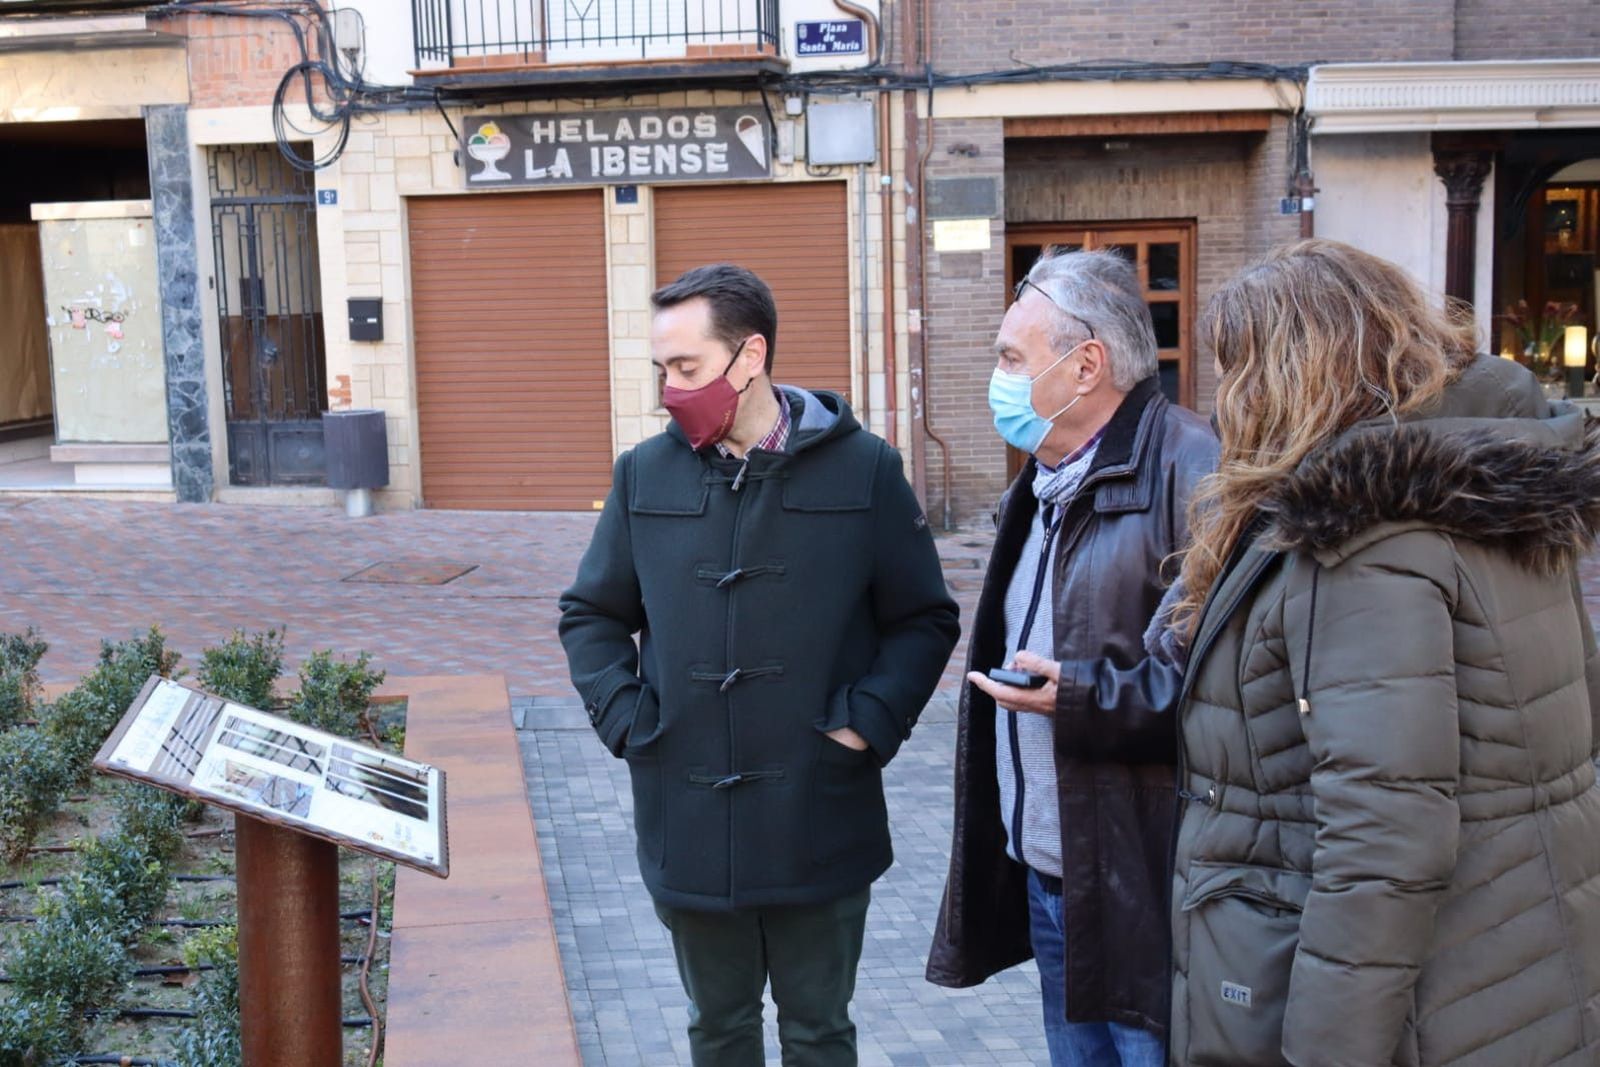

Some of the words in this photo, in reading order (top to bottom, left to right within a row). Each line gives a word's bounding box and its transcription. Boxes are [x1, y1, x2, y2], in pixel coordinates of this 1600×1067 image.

[819, 23, 847, 33] Plaza
[823, 32, 836, 42] de
[800, 42, 827, 53] Santa
[532, 115, 717, 144] HELADOS
[524, 148, 573, 179] LA
[590, 142, 729, 177] IBENSE
[1223, 987, 1248, 1003] EXIT
